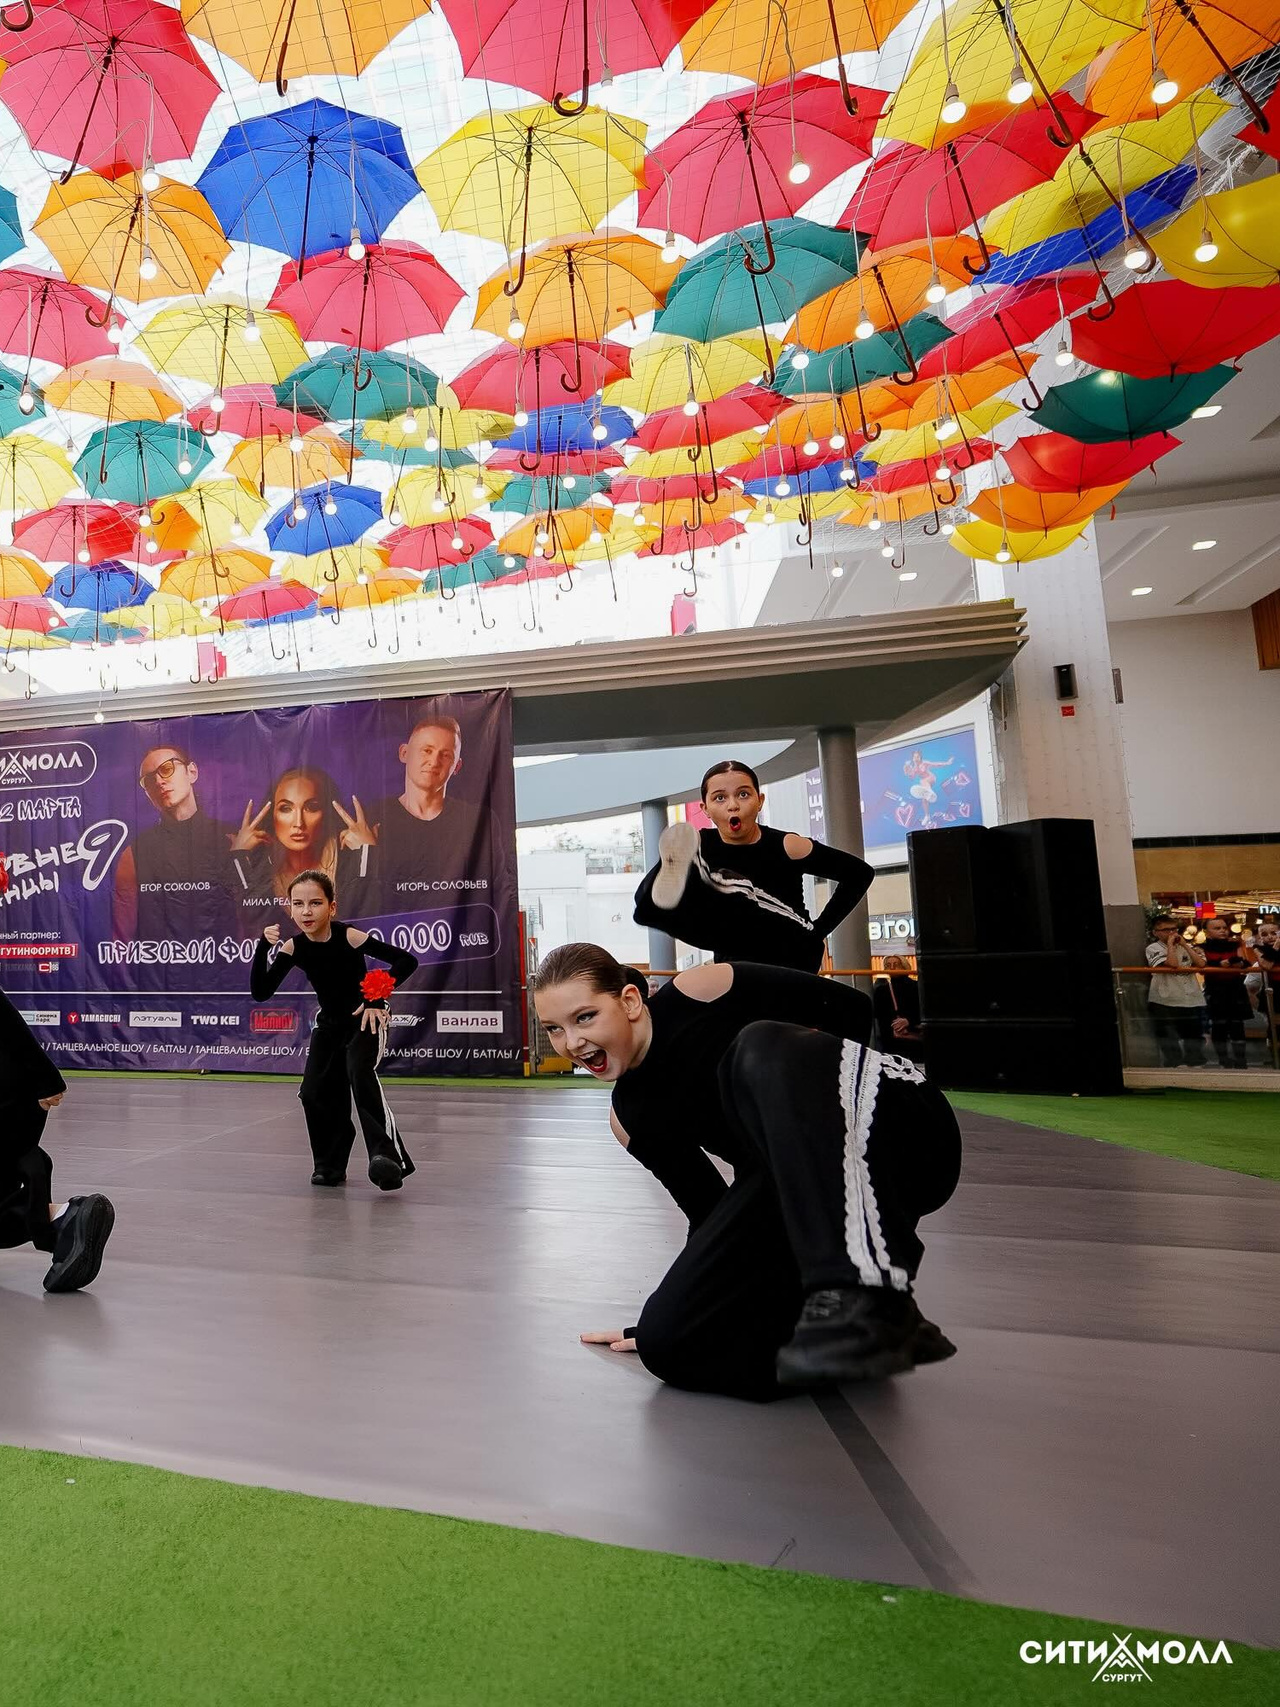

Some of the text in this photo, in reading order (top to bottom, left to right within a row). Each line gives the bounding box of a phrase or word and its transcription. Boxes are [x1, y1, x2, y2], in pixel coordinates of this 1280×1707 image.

[1, 777, 26, 785] СУРГУТ
[18, 796, 82, 821] МАРТА
[140, 882, 211, 892] ЕГОР СОКОЛОВ
[396, 880, 488, 892] ИГОРЬ СОЛОВЬЕВ
[243, 897, 272, 907] МИЛА
[1259, 905, 1280, 914] ПА
[20, 931, 62, 941] партнер:
[391, 919, 452, 953] 000
[459, 932, 489, 948] RUB
[98, 936, 216, 965] ПРИЗОВОЙ
[191, 1015, 240, 1025] TWO KEI
[52, 1043, 120, 1052] ТАНЦЕВАЛЬНОЕ
[121, 1044, 145, 1053] ШОУ
[153, 1044, 187, 1053] БАТТЛЫ
[195, 1045, 270, 1056] ТАНЦЕВАЛЬНОЕ
[271, 1046, 296, 1056] ШОУ
[383, 1048, 433, 1058] ВАЛЬНОЕ
[435, 1049, 463, 1058] ШОУ
[473, 1049, 513, 1059] БАТТЛЫ
